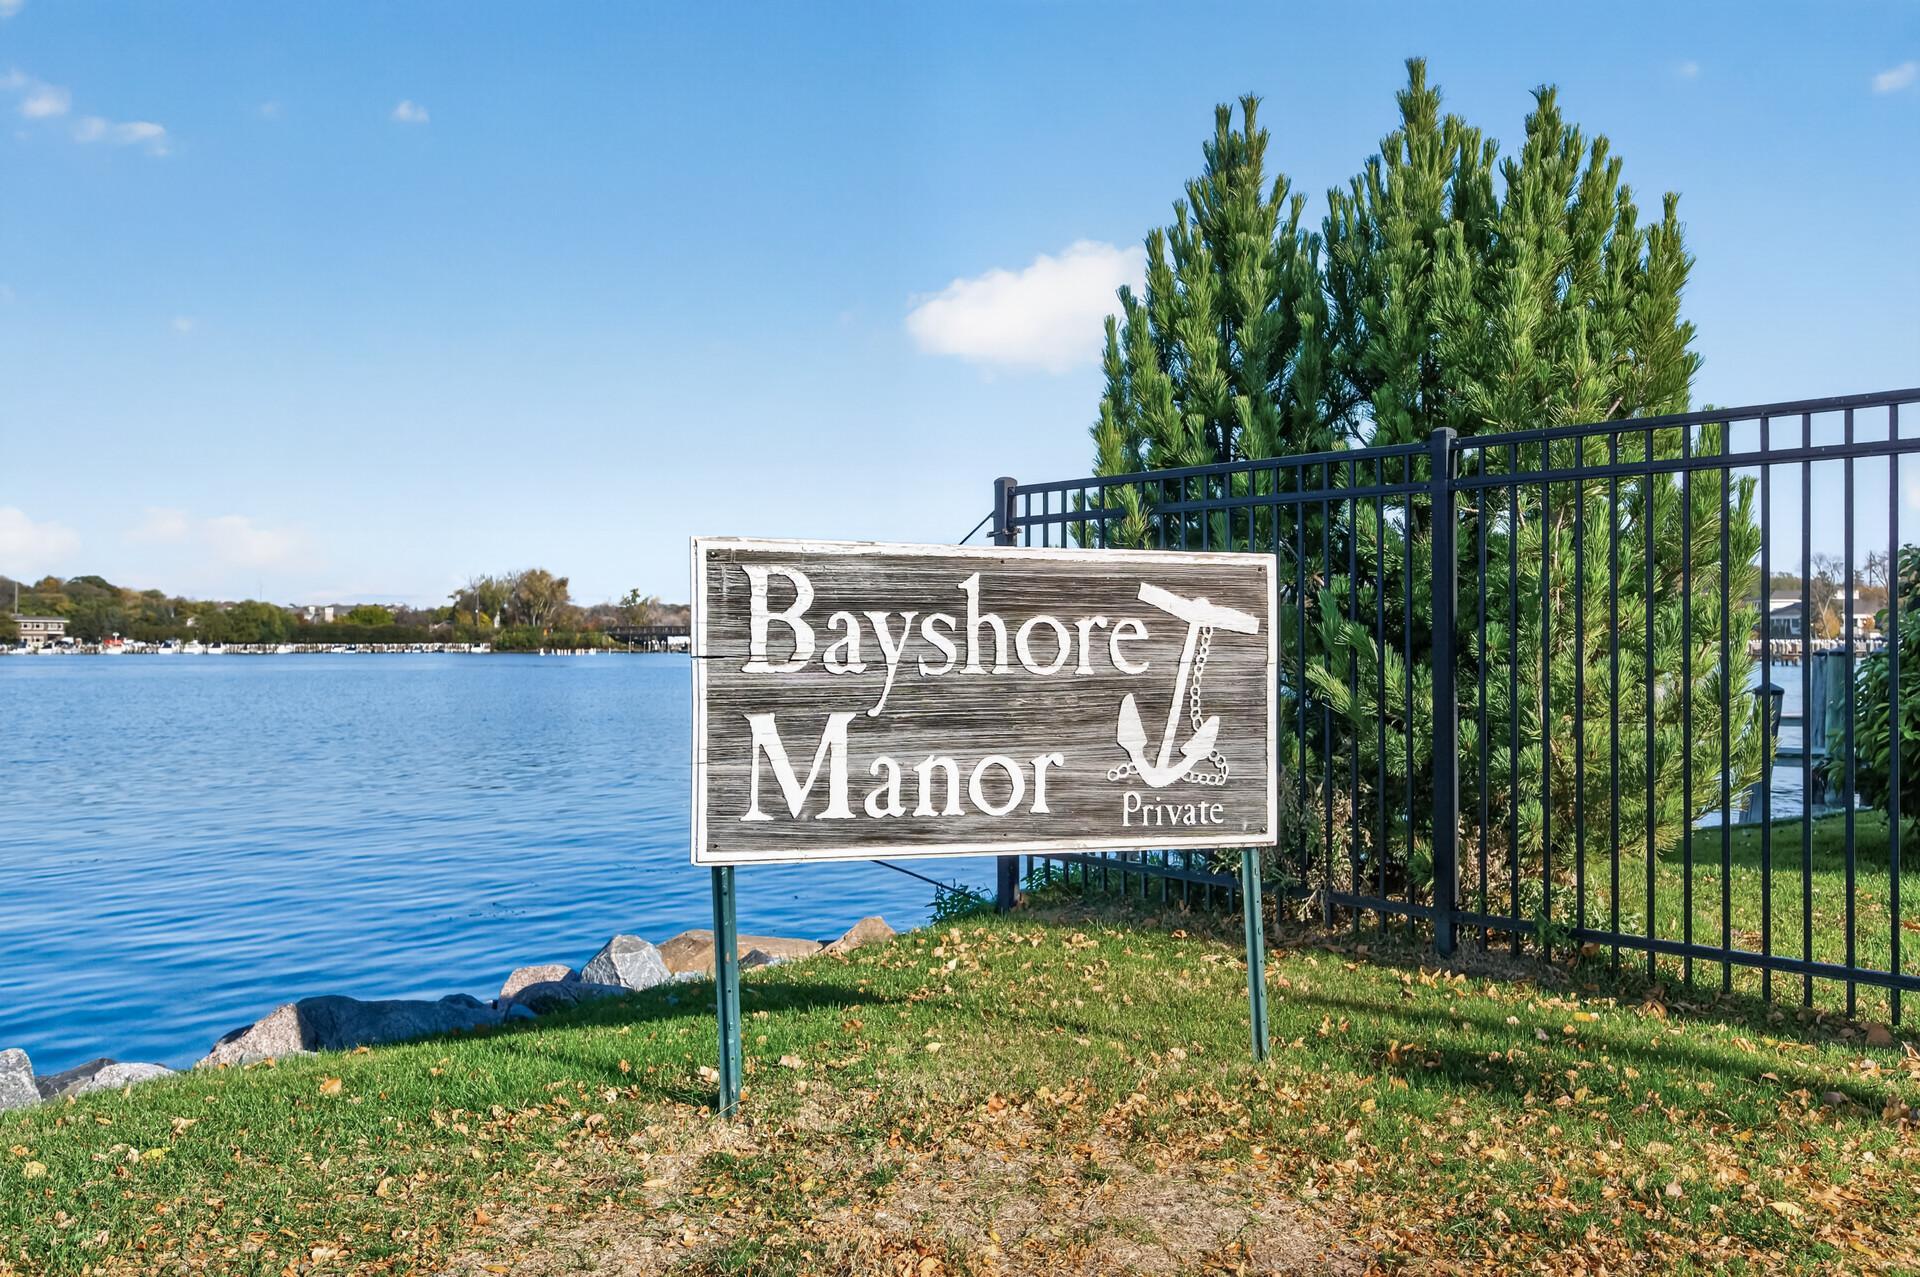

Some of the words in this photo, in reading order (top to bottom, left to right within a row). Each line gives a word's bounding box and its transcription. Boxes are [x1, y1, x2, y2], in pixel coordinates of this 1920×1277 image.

[741, 564, 1150, 717] Bayshore
[740, 712, 1064, 820] Manor
[1122, 790, 1224, 827] Private
